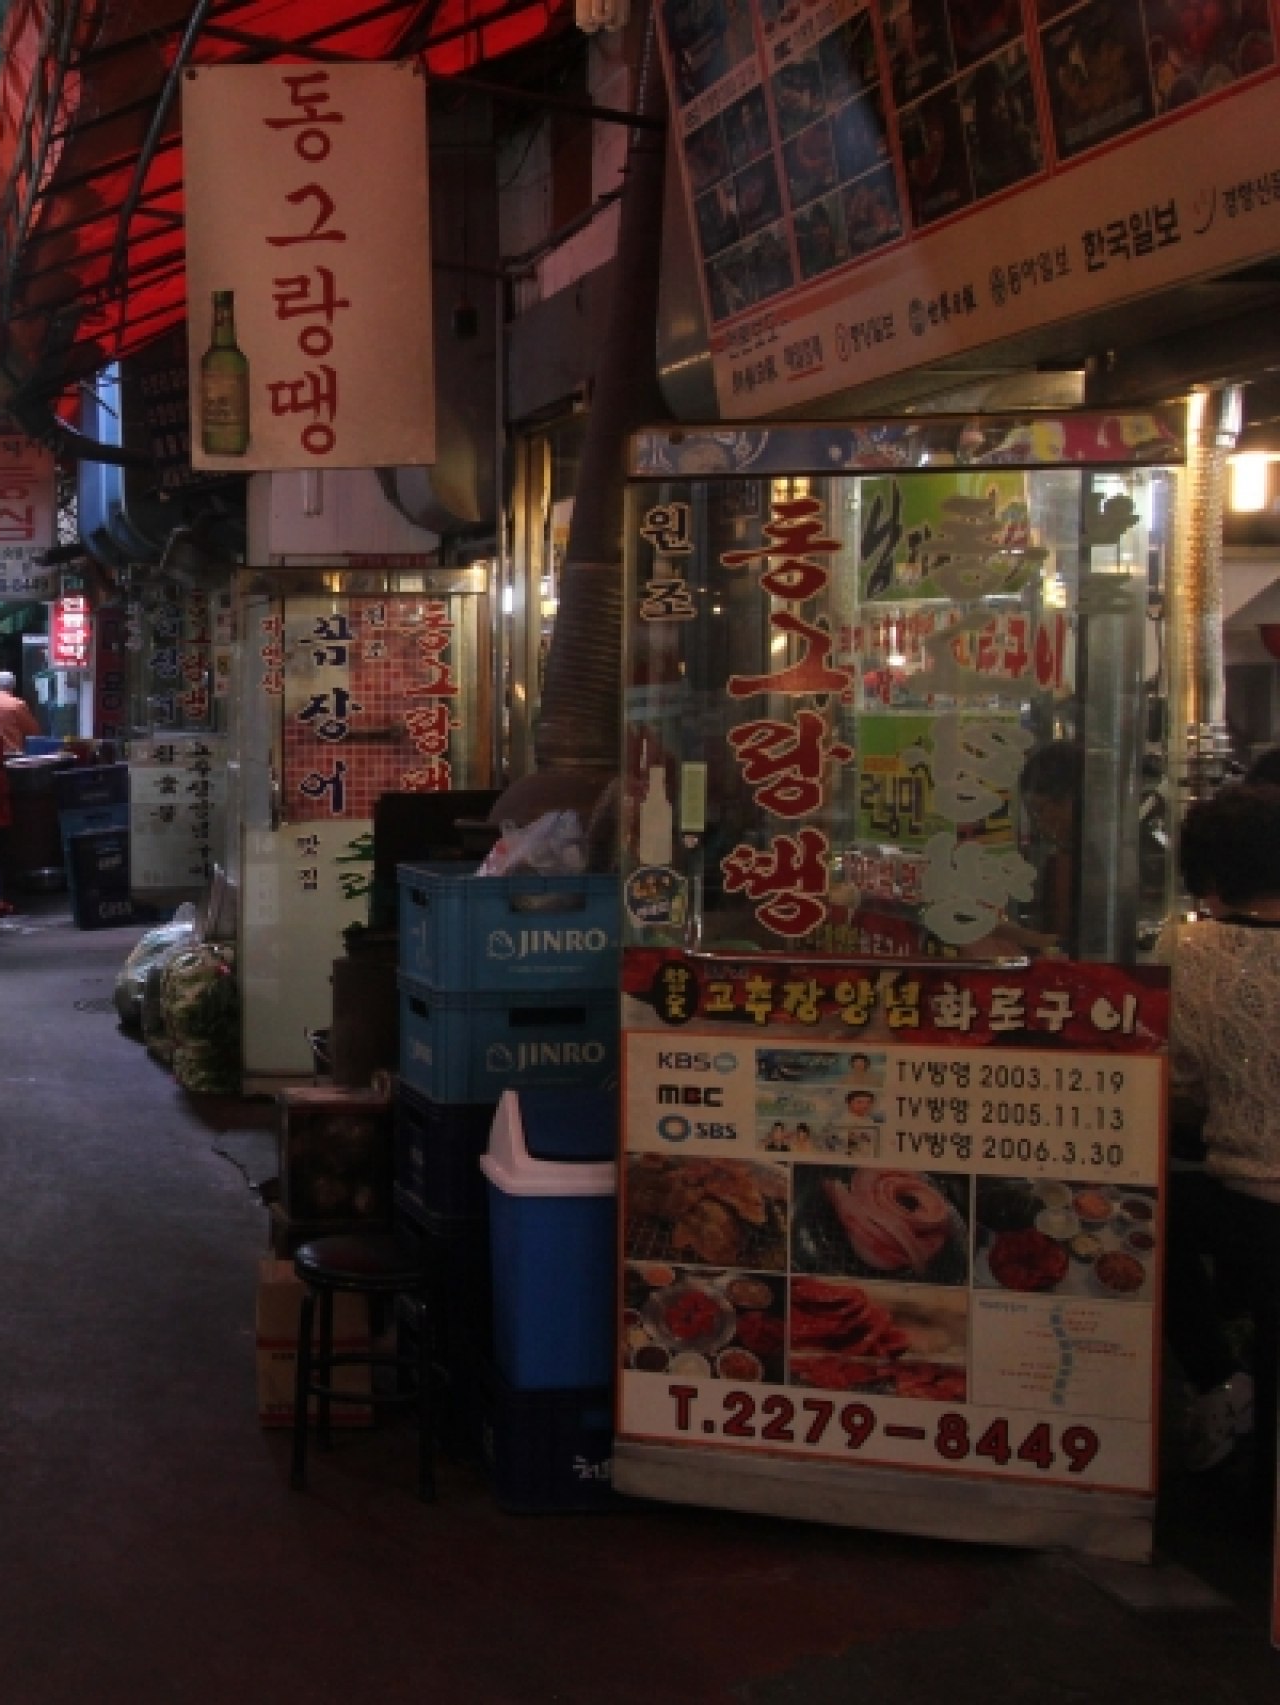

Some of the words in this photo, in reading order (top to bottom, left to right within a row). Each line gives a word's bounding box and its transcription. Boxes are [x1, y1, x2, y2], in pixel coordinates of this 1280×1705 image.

[1082, 198, 1181, 273] 한국일보
[262, 70, 352, 457] 동그랑땡
[641, 504, 695, 619] 원조
[722, 497, 854, 938] 동그랑땡
[515, 928, 607, 960] JINRO
[516, 1040, 606, 1073] JINRO
[657, 1051, 710, 1072] KBS
[979, 1064, 1125, 1094] 2003.12.19
[657, 1084, 724, 1108] MBC
[694, 1122, 738, 1141] SBS
[980, 1100, 1125, 1130] 2005.11.13
[981, 1135, 1124, 1168] 2006.3.30
[668, 1385, 1102, 1473] T.2279-8449
